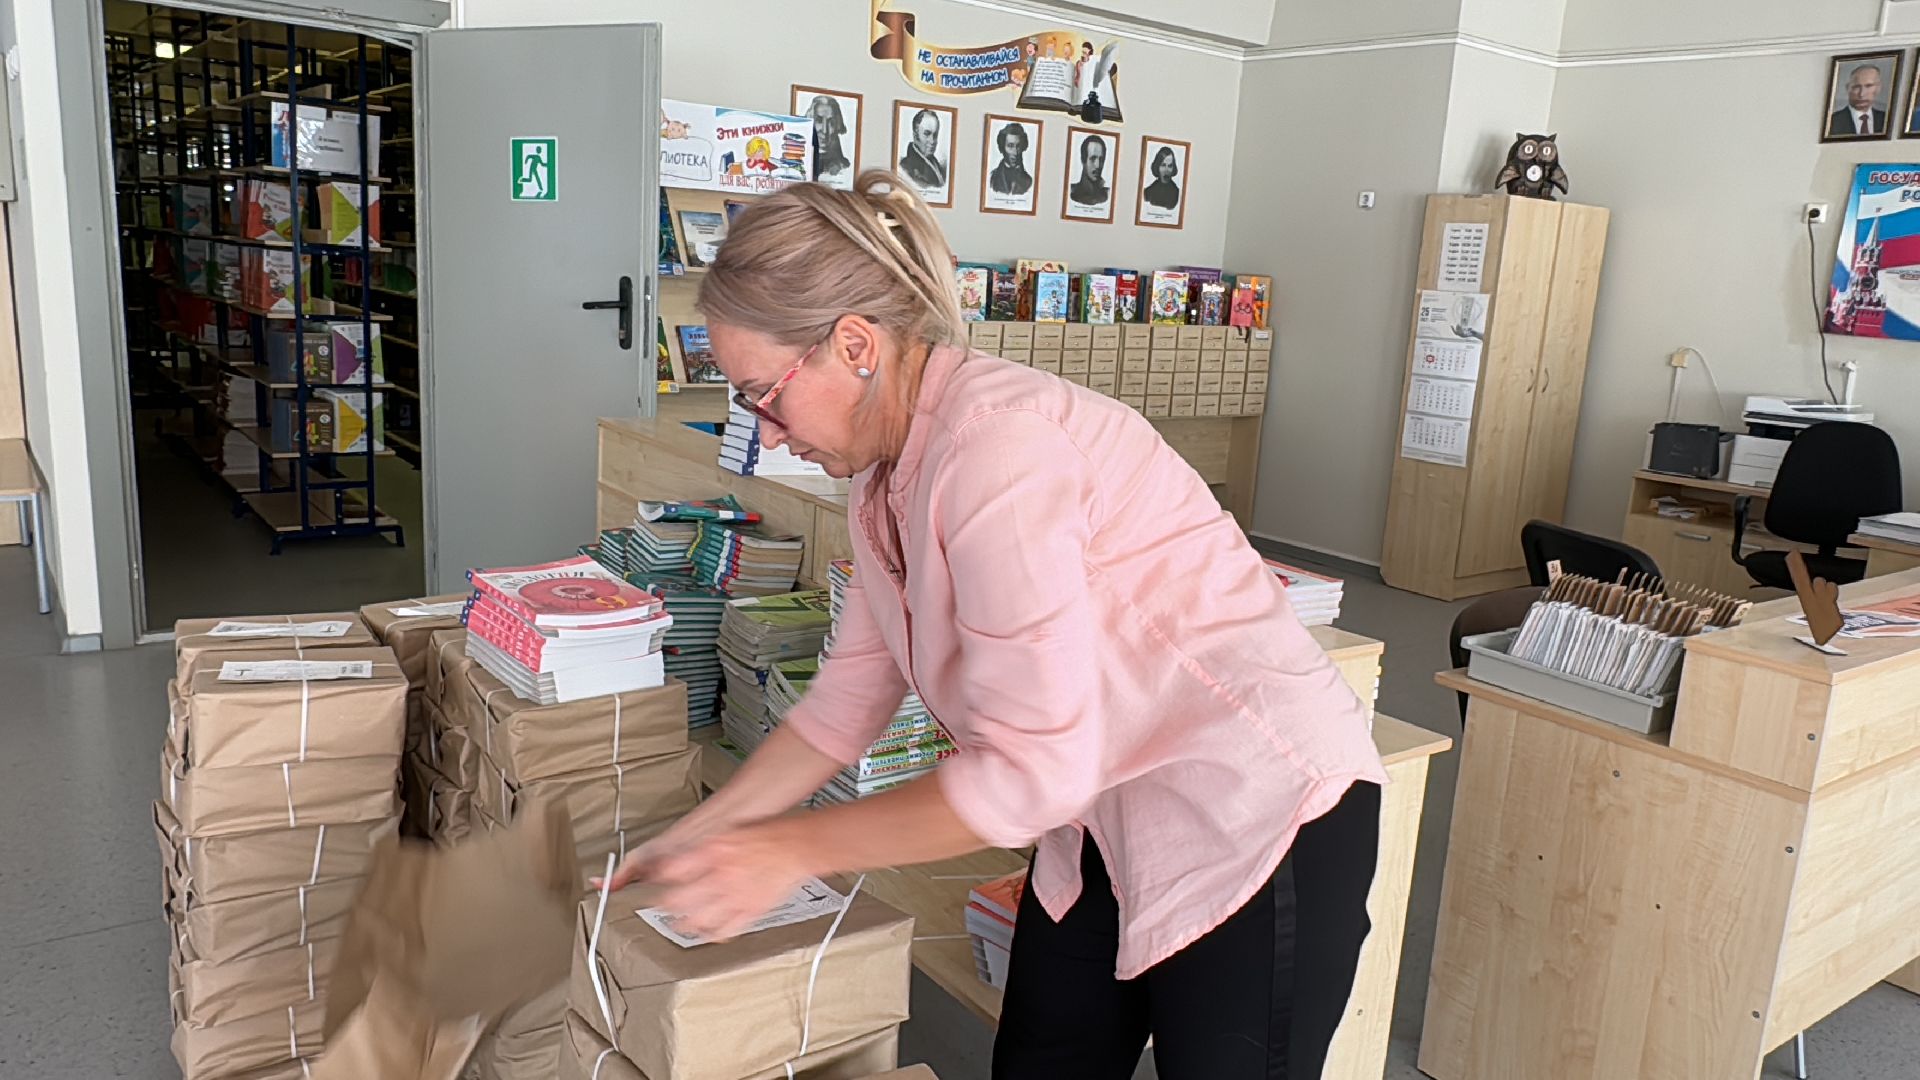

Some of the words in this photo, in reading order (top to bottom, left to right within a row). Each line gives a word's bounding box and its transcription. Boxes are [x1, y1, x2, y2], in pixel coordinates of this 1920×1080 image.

[917, 48, 931, 64] НЕ
[936, 47, 1020, 69] ОСТАНАВЛИВАЙСЯ
[920, 69, 934, 84] НА
[940, 68, 1009, 88] ПРОЧИТАННОМ
